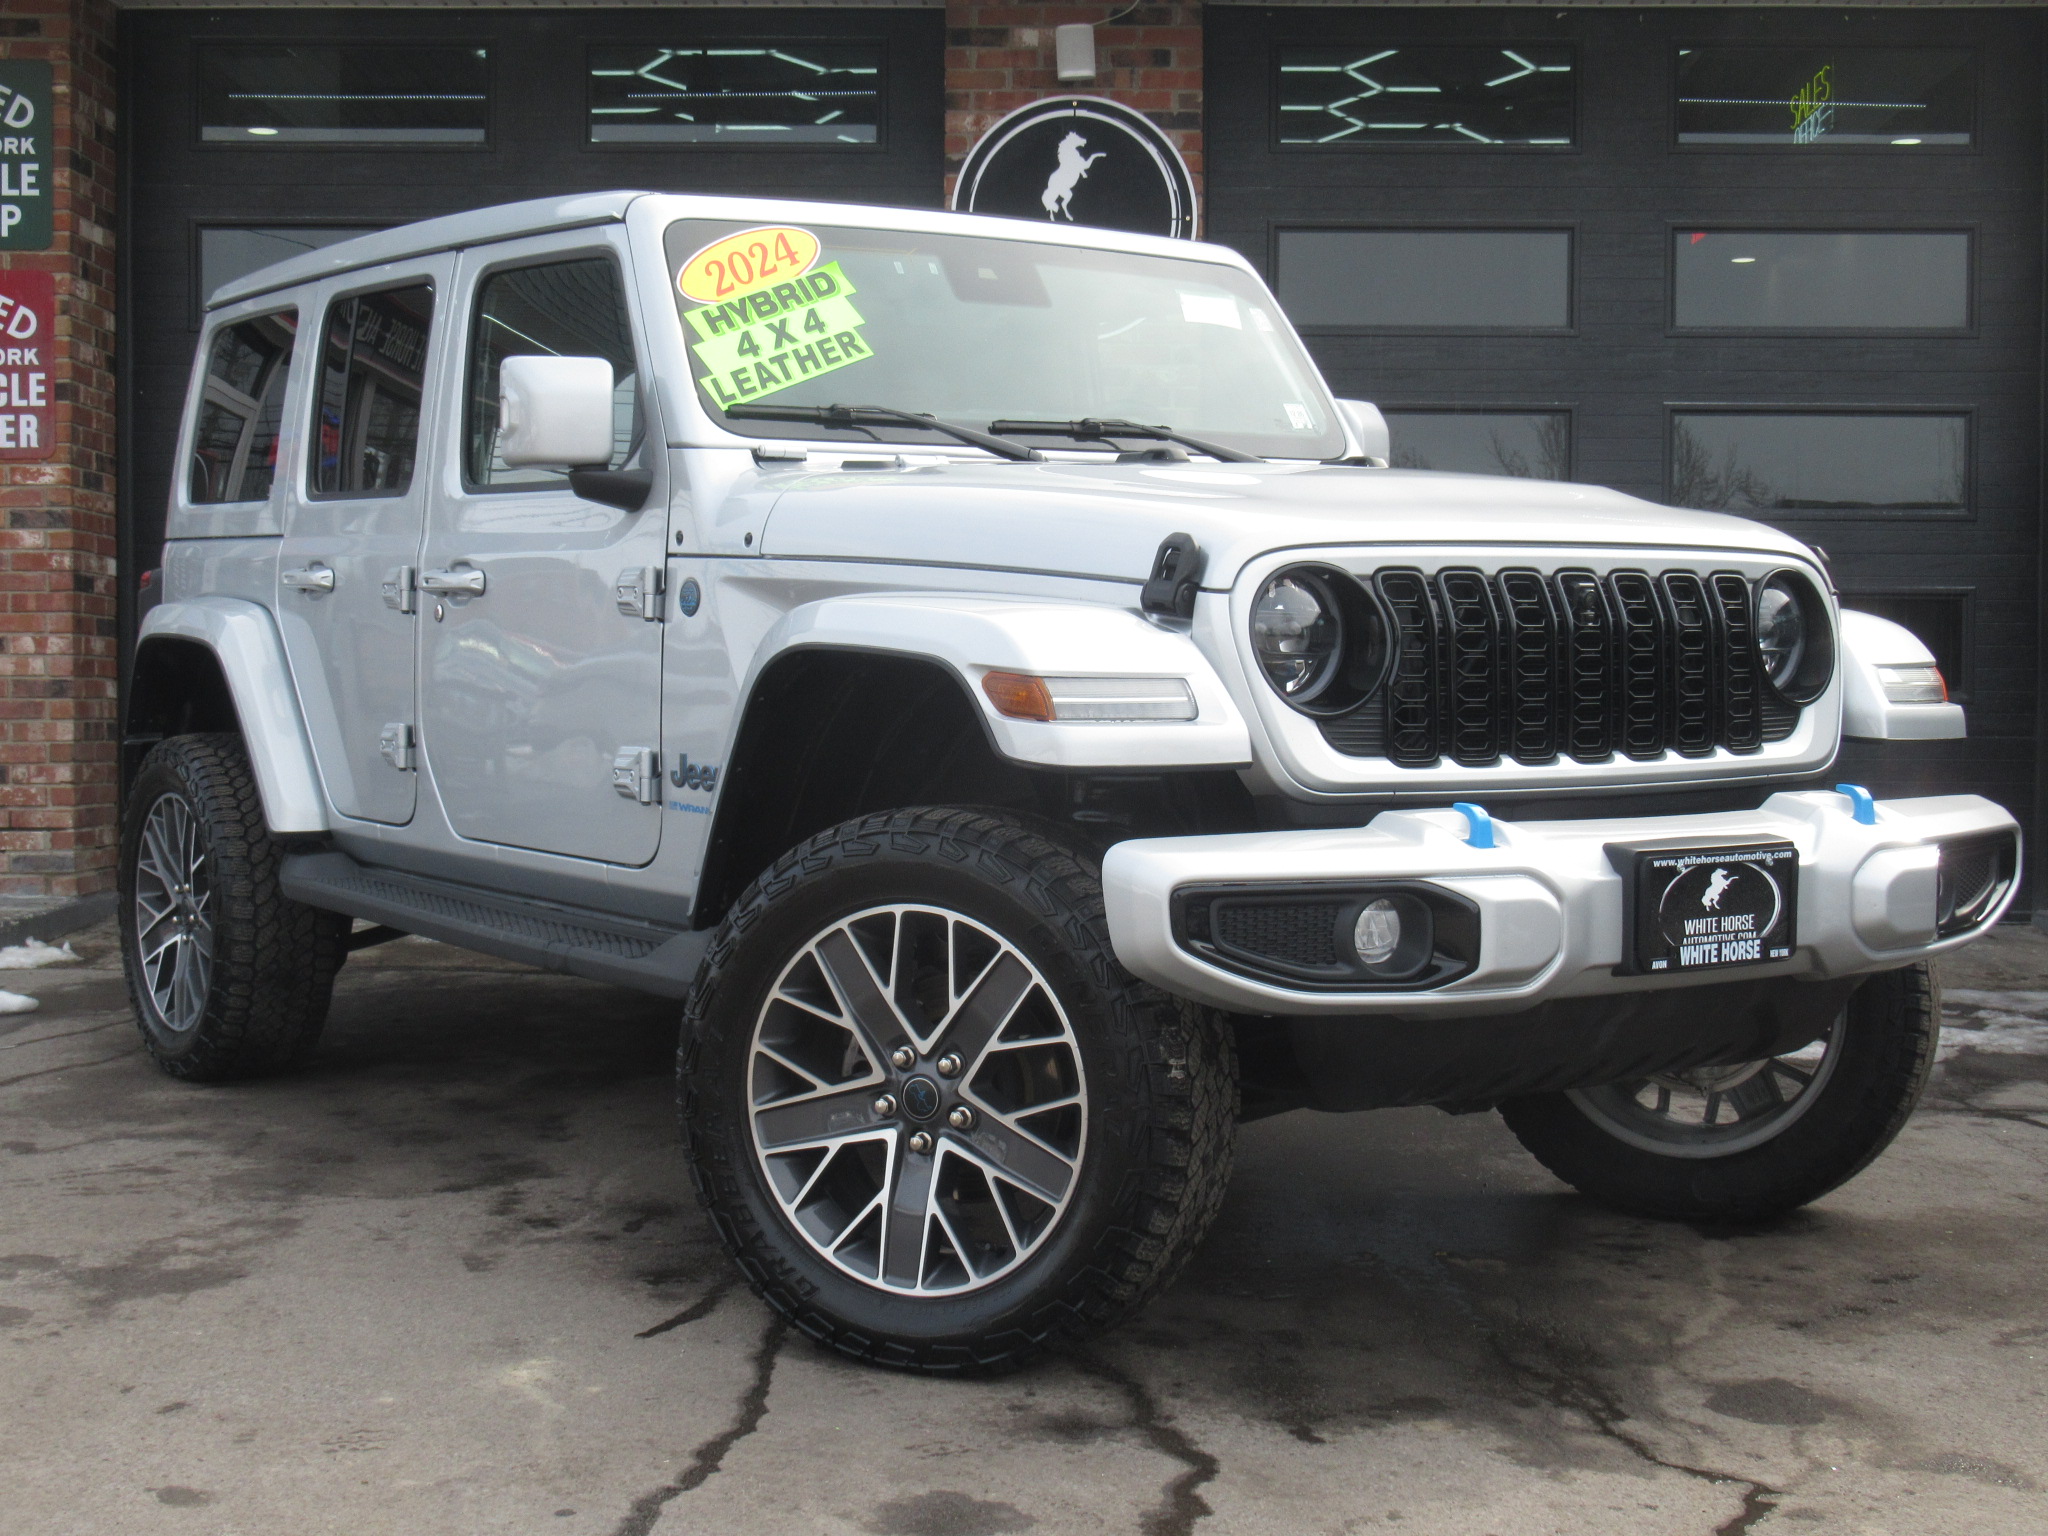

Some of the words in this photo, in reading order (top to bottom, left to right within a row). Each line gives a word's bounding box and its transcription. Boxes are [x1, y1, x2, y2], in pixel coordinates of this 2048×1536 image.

[1789, 65, 1831, 130] SALES
[0, 137, 36, 155] RK
[704, 232, 801, 297] 2024
[700, 271, 839, 336] HYBRID
[710, 330, 866, 406] LEATHER
[670, 753, 718, 792] Jee
[678, 802, 711, 815] WRAN
[1653, 851, 1792, 868] www.whitehorseautomotive.com
[1684, 917, 1719, 935] WHITE
[1721, 914, 1755, 932] HORSE
[1651, 960, 1668, 970] AVON
[1680, 942, 1719, 966] WHITE
[1721, 939, 1761, 962] HORSE
